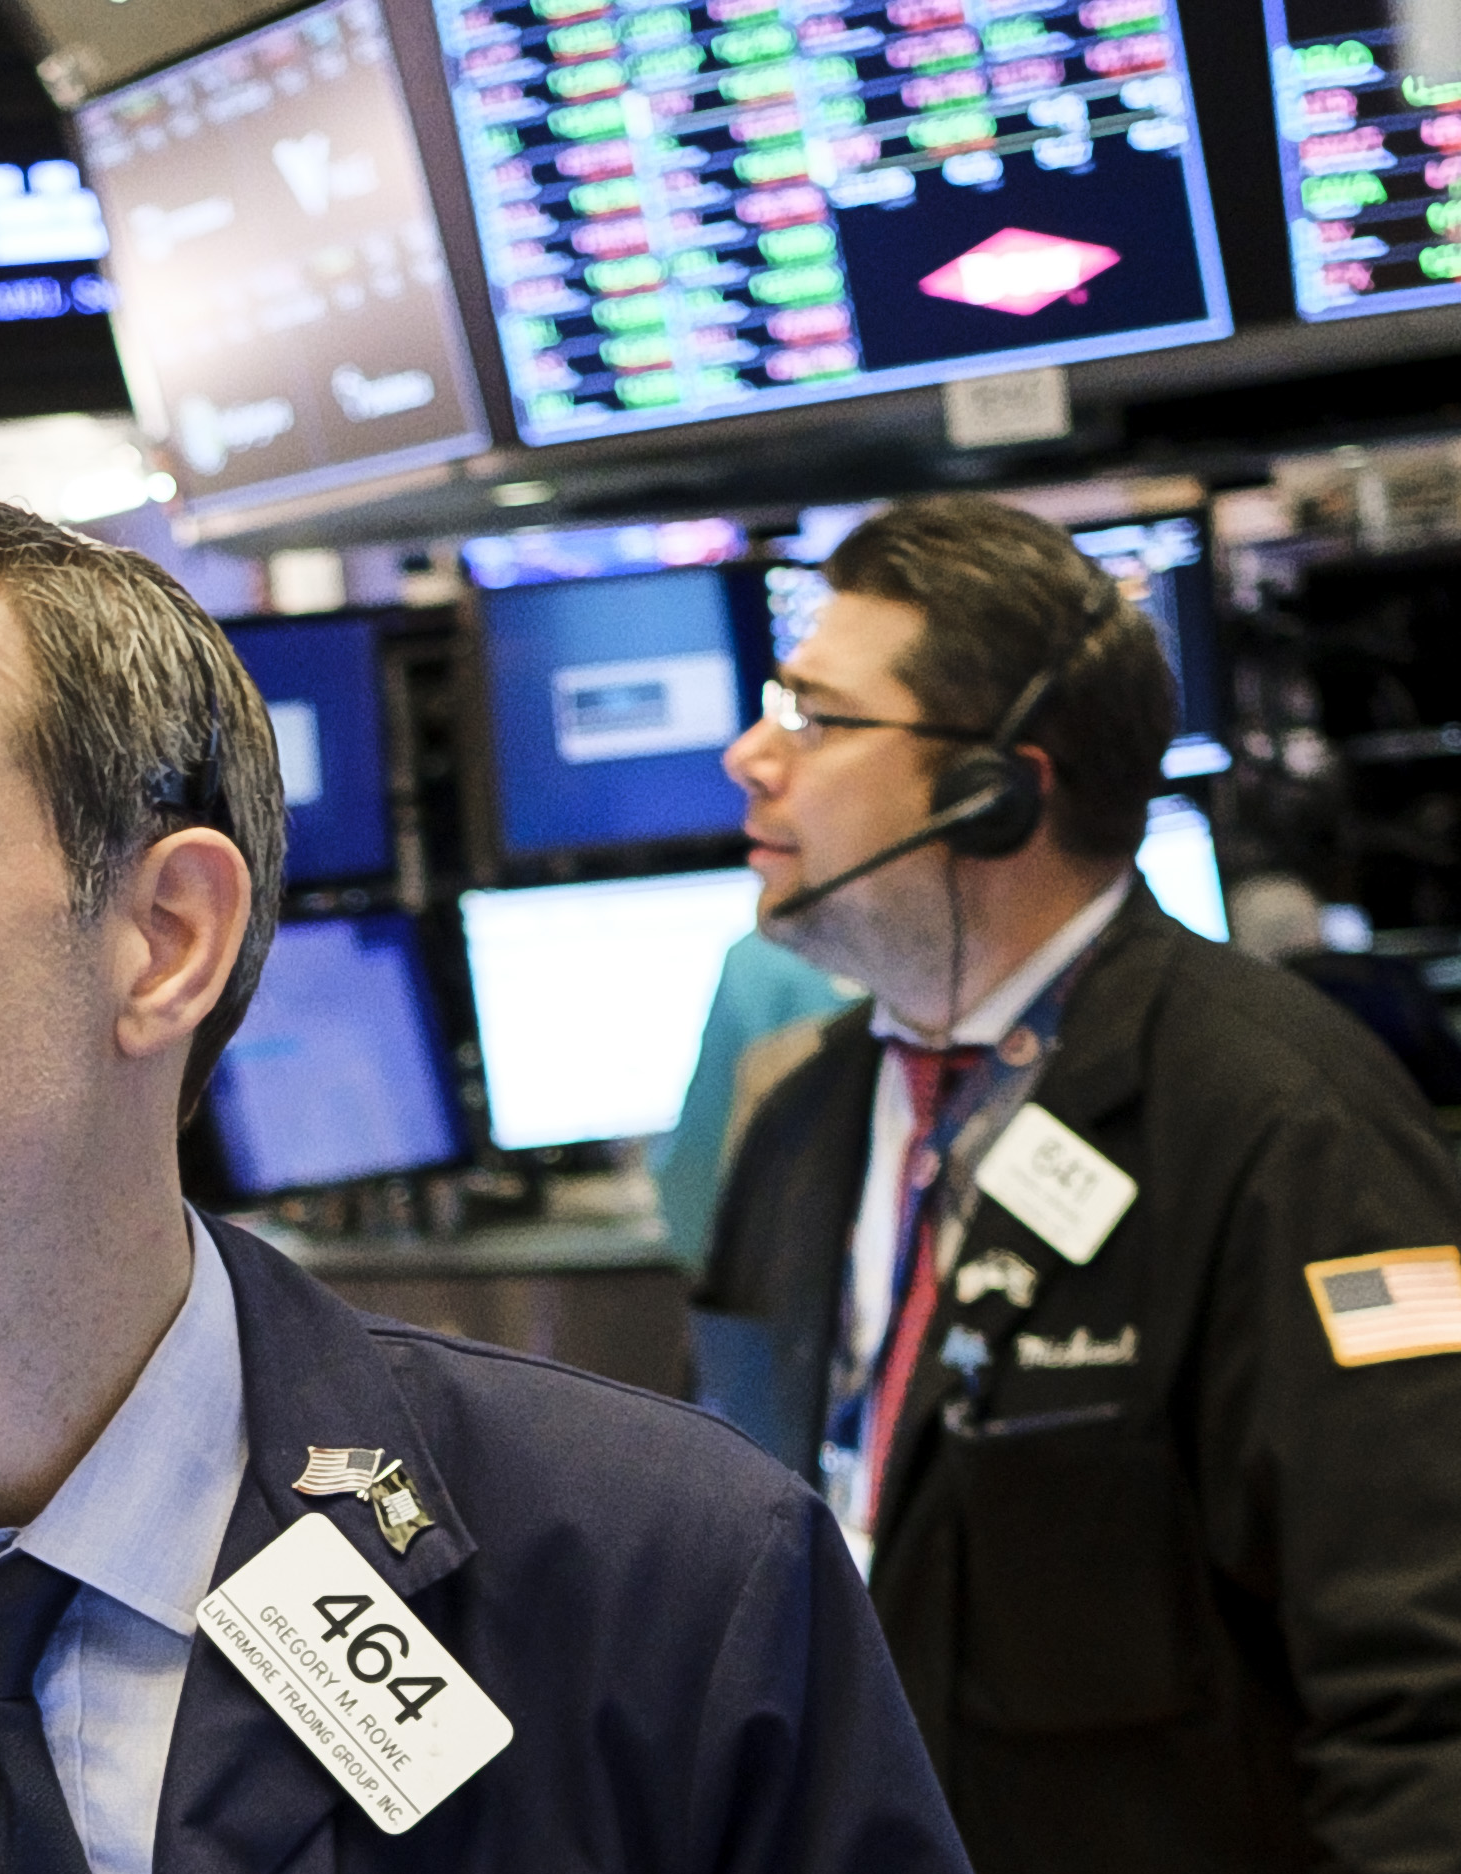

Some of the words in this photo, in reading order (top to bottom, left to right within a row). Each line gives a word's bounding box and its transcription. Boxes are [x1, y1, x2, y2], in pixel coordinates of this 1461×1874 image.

[202, 1599, 282, 1685] LIVERMORE
[277, 1680, 336, 1745] TRADING
[259, 1605, 342, 1689] GREGORY
[333, 1689, 359, 1718] M.
[356, 1713, 413, 1773] ROWE
[312, 1594, 449, 1726] 464
